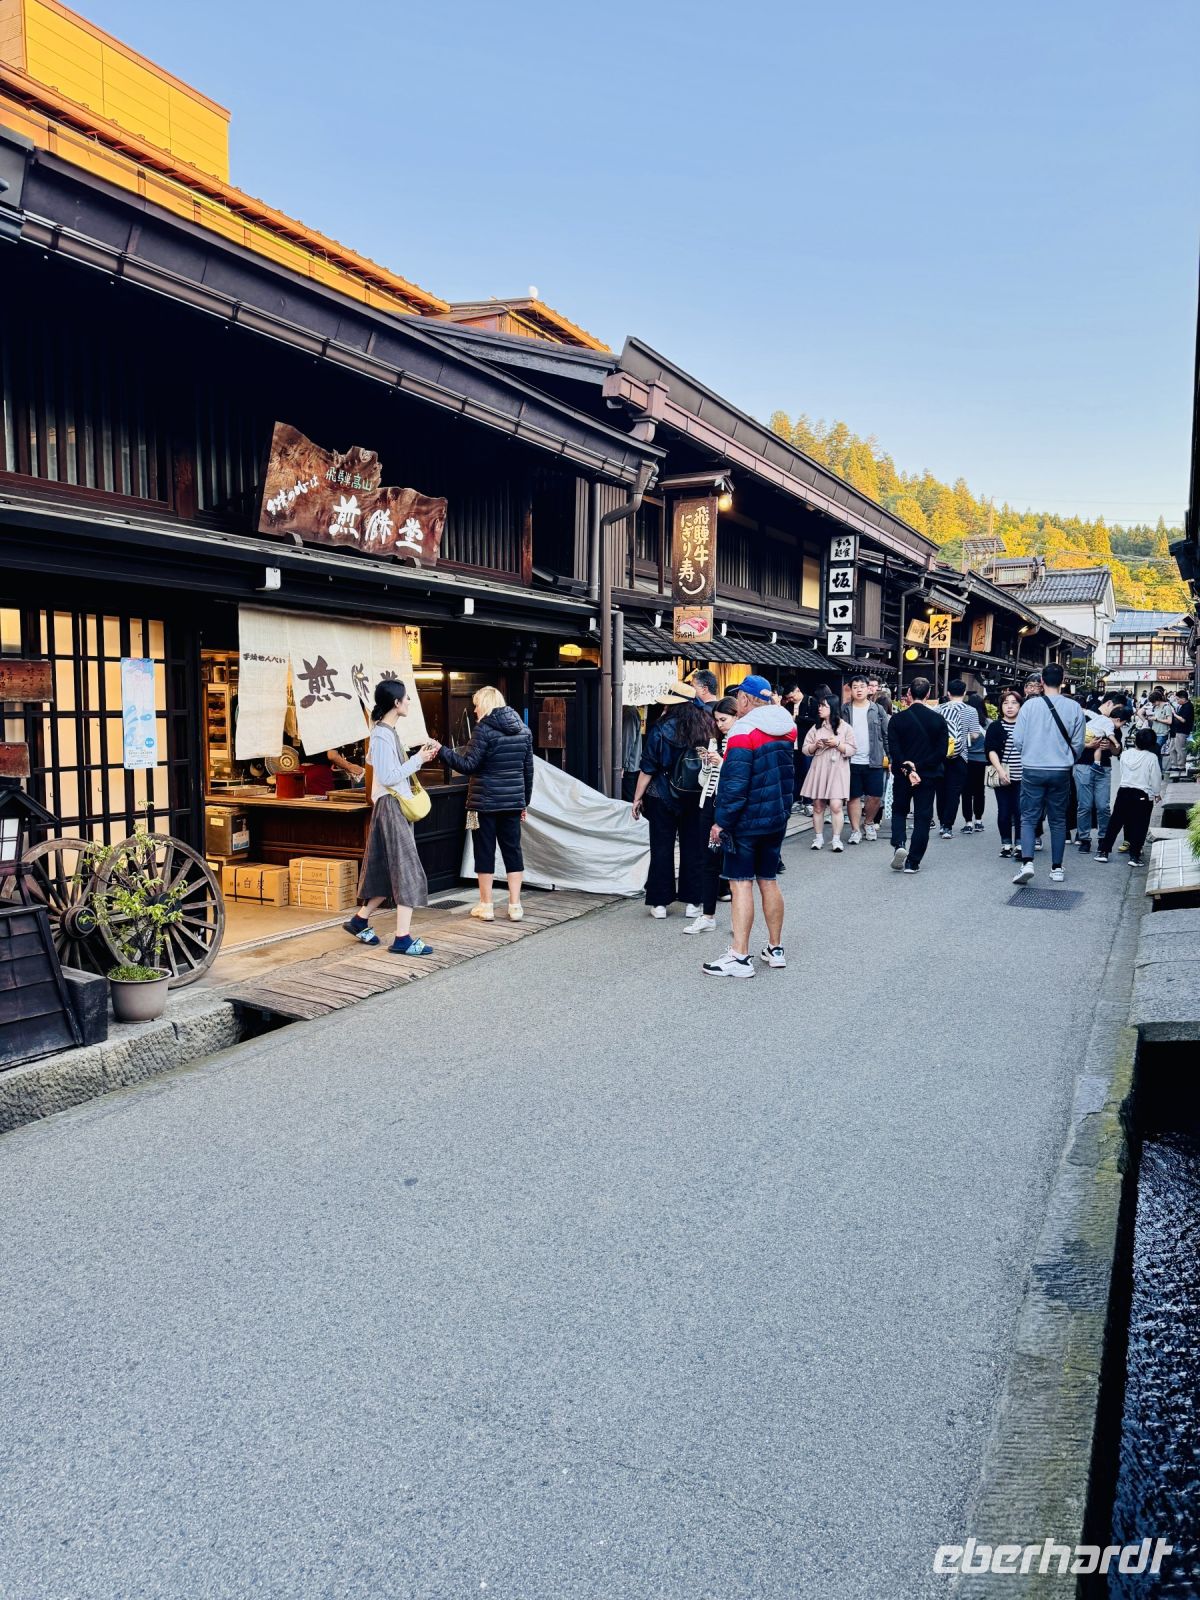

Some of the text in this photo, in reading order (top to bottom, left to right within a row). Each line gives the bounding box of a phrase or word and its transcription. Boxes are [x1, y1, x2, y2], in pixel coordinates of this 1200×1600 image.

[325, 466, 372, 491] 飛騨高山
[328, 494, 424, 554] 煎餅堂
[693, 506, 710, 568] 飛騨牛
[675, 631, 695, 639] SUSHI
[831, 571, 851, 653] 坂口屋
[931, 618, 949, 642] 箸
[296, 654, 398, 708] 煎餅
